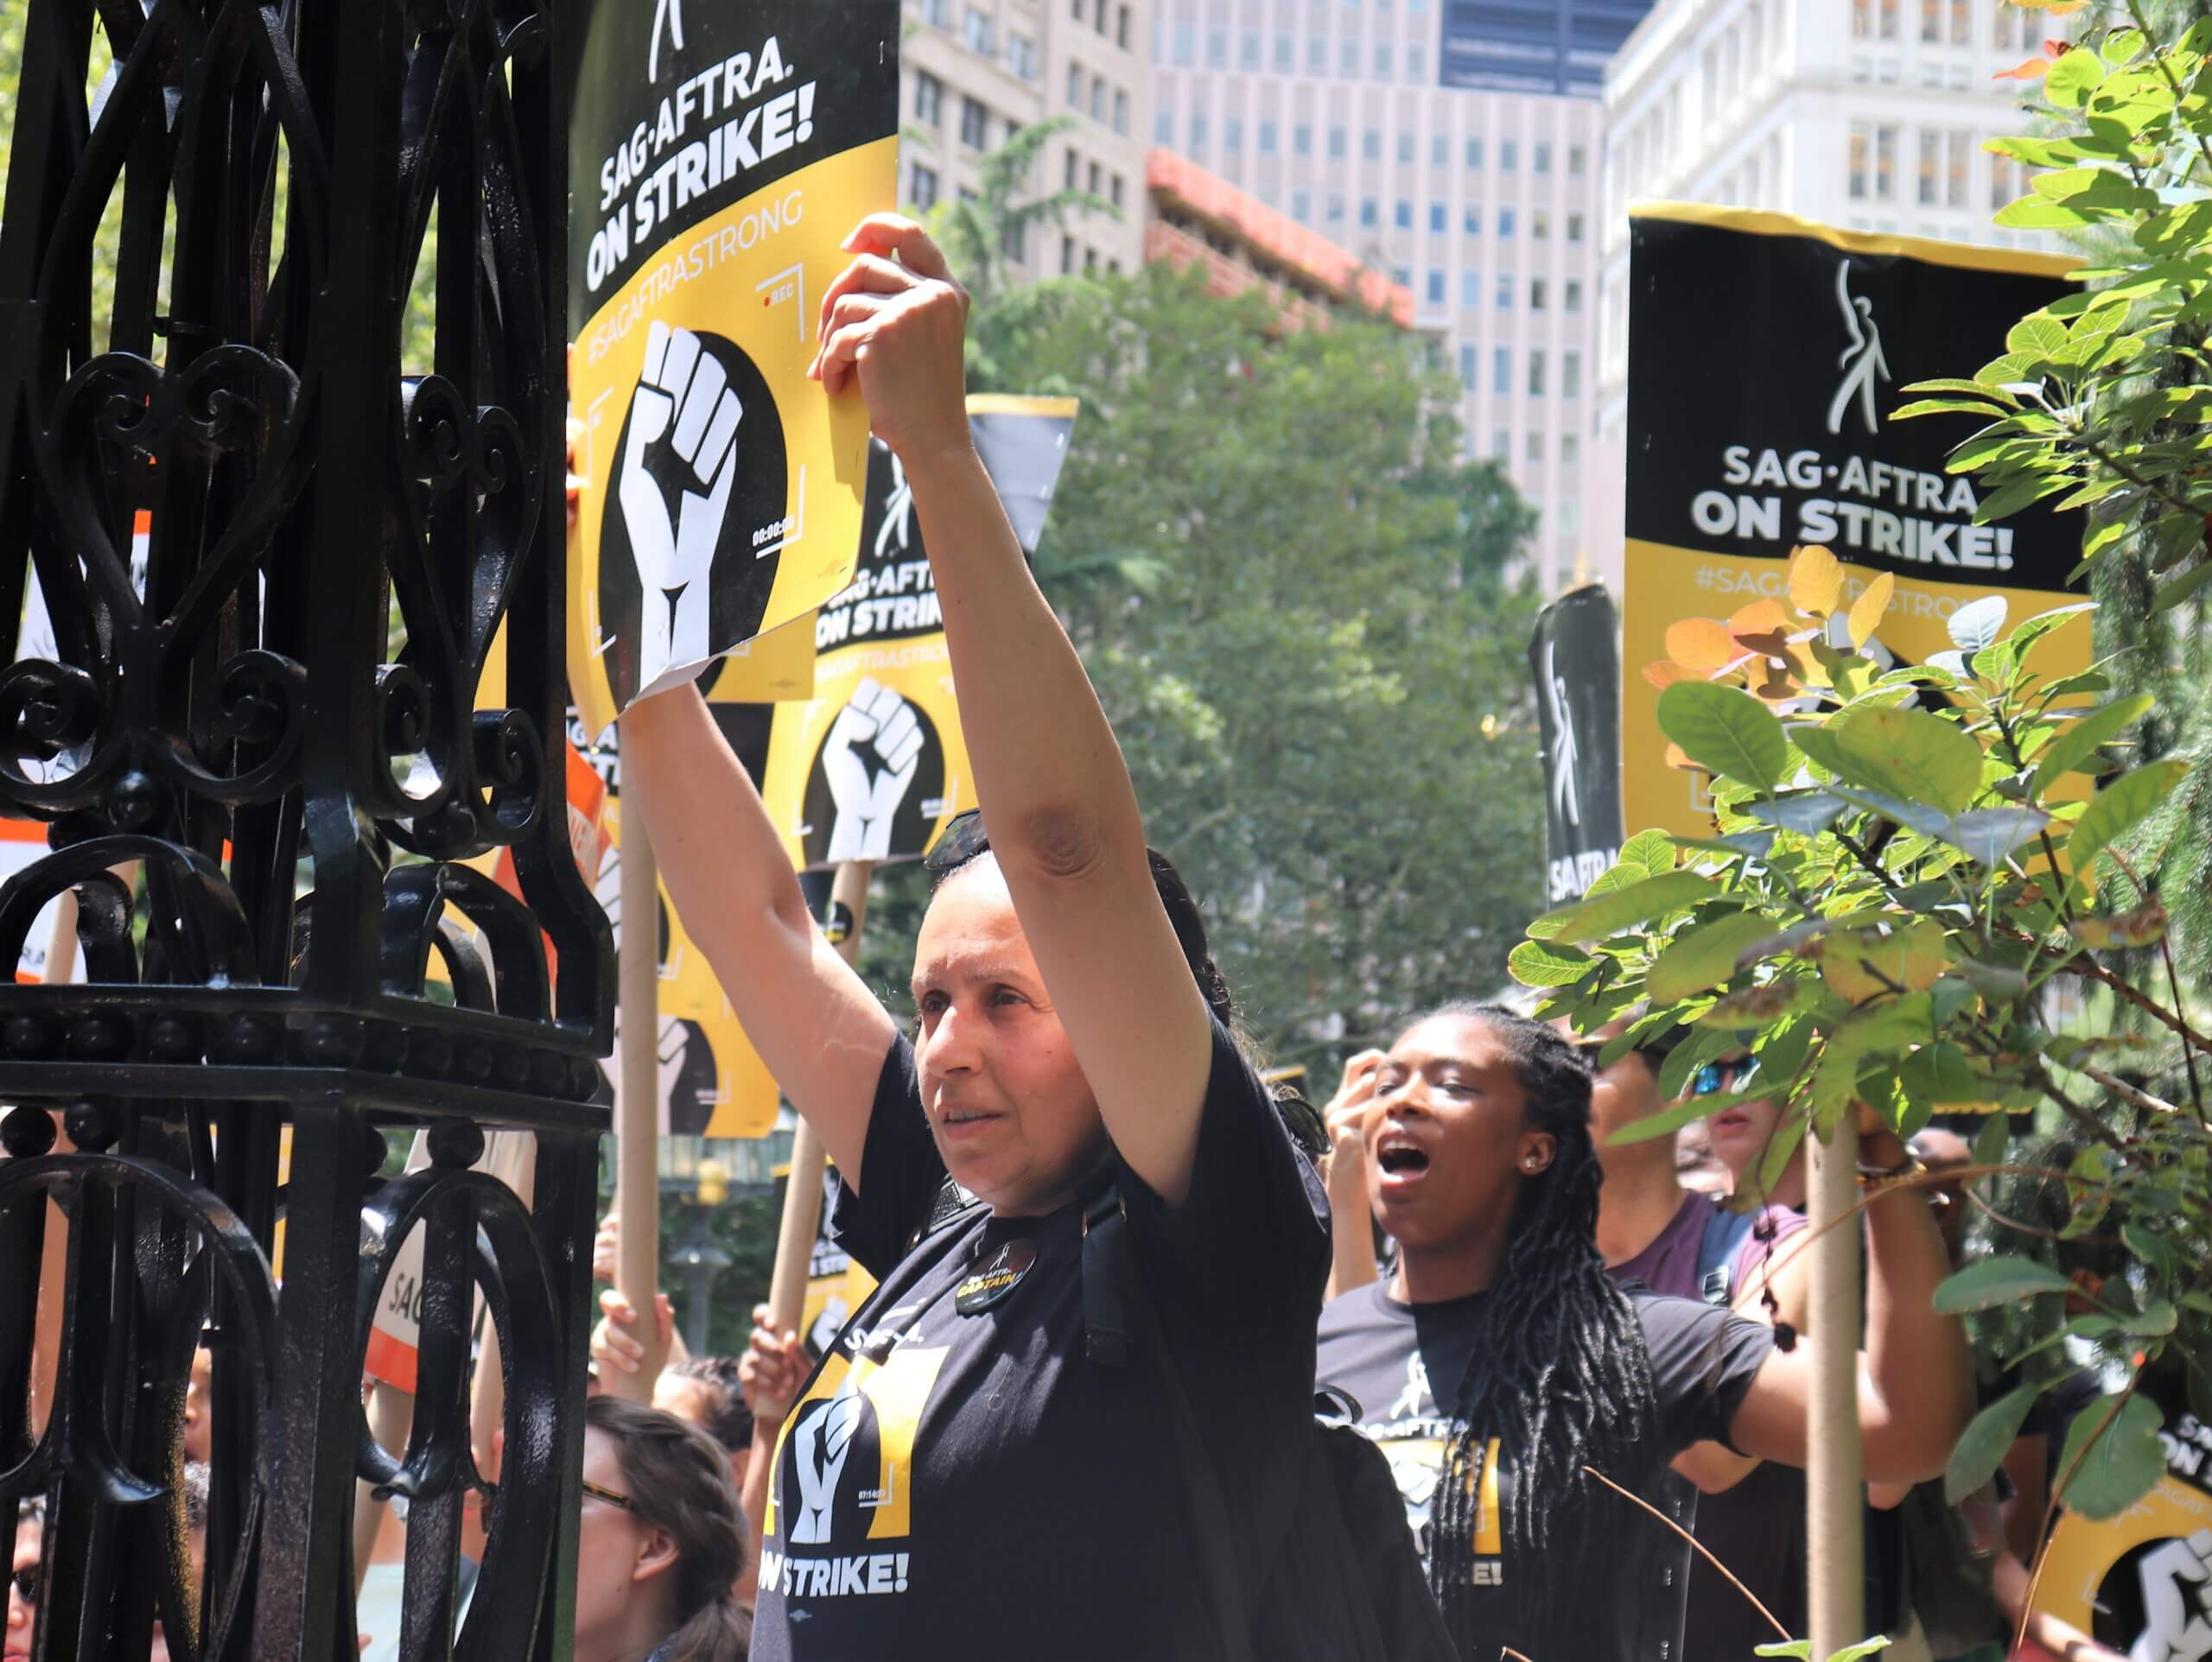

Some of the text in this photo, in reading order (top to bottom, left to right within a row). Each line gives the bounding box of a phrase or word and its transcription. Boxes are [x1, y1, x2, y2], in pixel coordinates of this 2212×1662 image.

[587, 80, 817, 293] ON STRIKE!
[588, 190, 803, 363] #SAGAFTRASTRONG
[770, 282, 794, 306] REC
[1691, 490, 2015, 571] ON STRIKE!
[816, 606, 851, 650] ON
[758, 1548, 910, 1597] N STRIKE!
